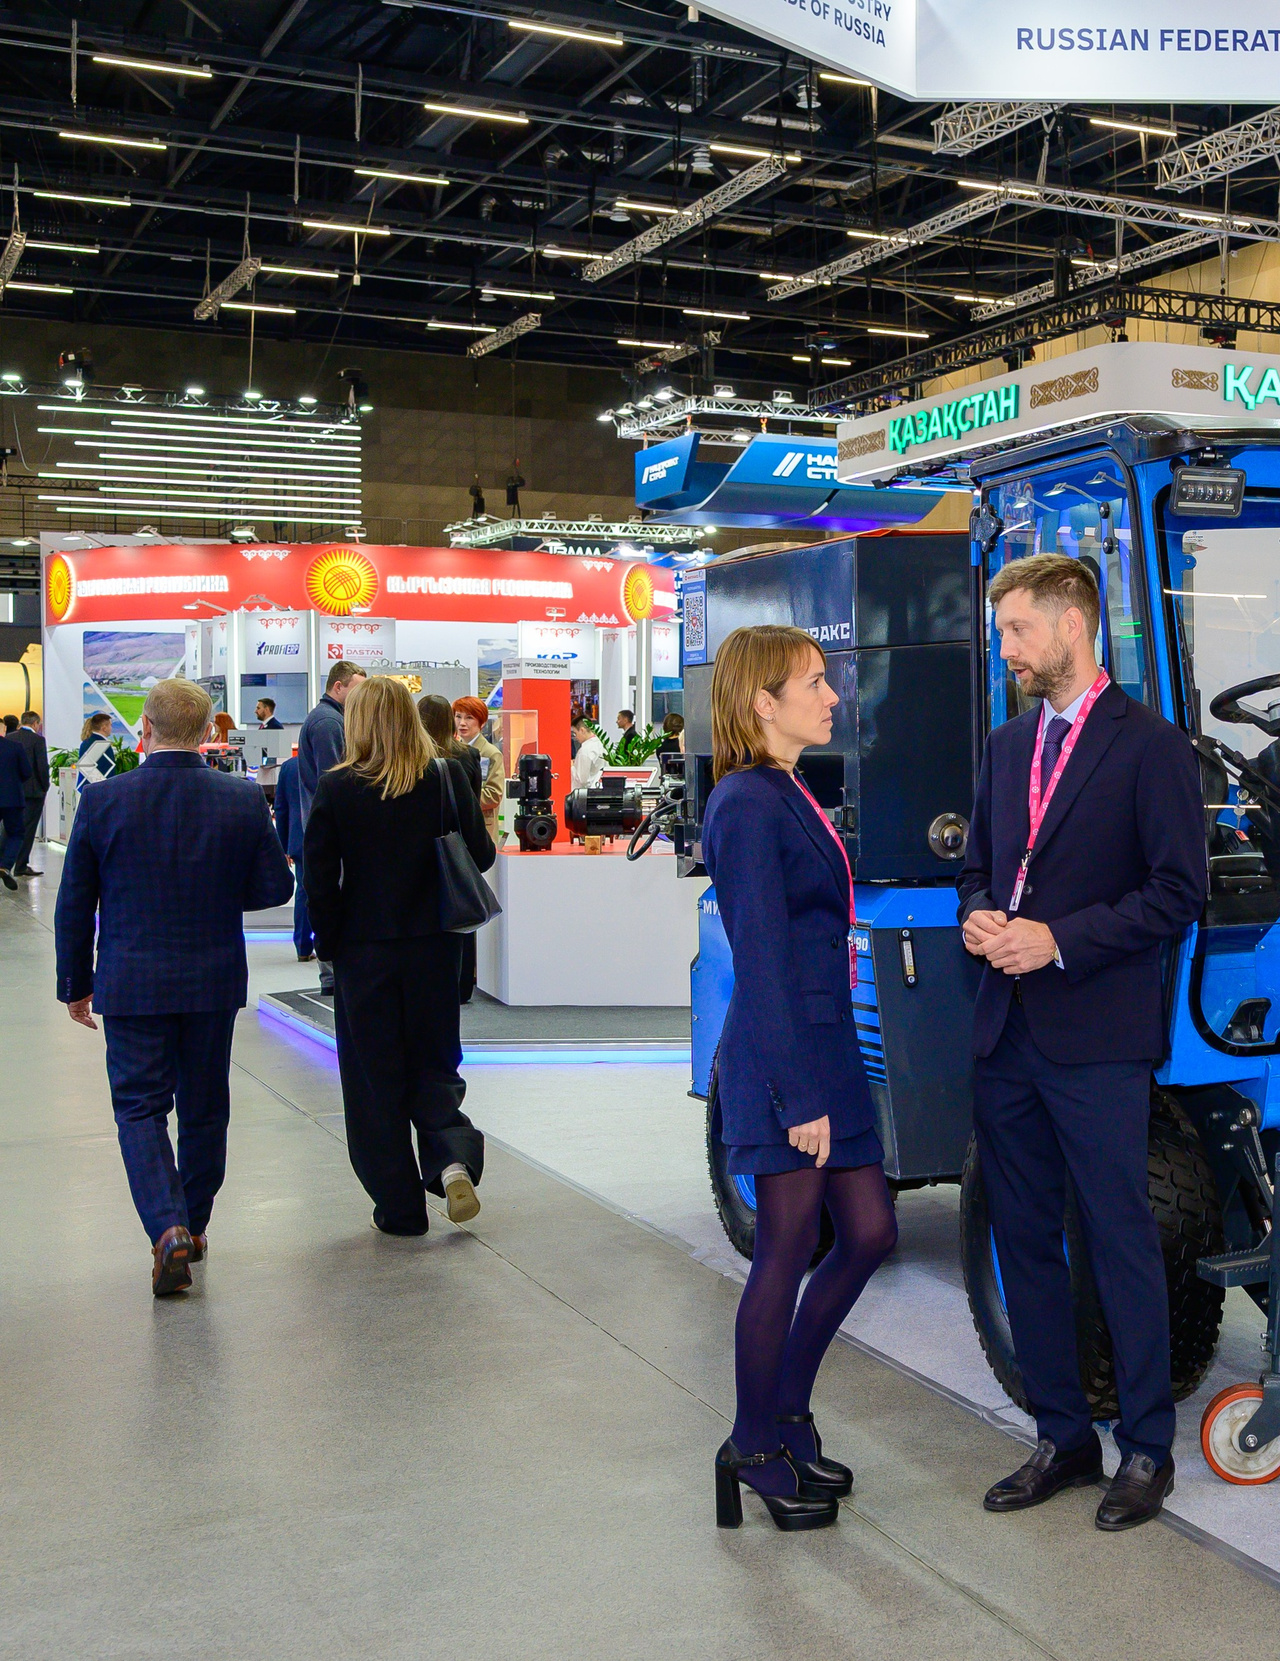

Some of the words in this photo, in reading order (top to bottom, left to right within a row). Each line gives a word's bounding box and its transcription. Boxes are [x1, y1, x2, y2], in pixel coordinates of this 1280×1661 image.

[848, 0, 886, 21] STRY
[811, 0, 829, 20] OF
[834, 8, 885, 47] RUSSIA
[1017, 28, 1149, 51] RUSSIAN
[889, 385, 1019, 454] ҚАЗАҚСТАН
[803, 623, 850, 642] РАКС
